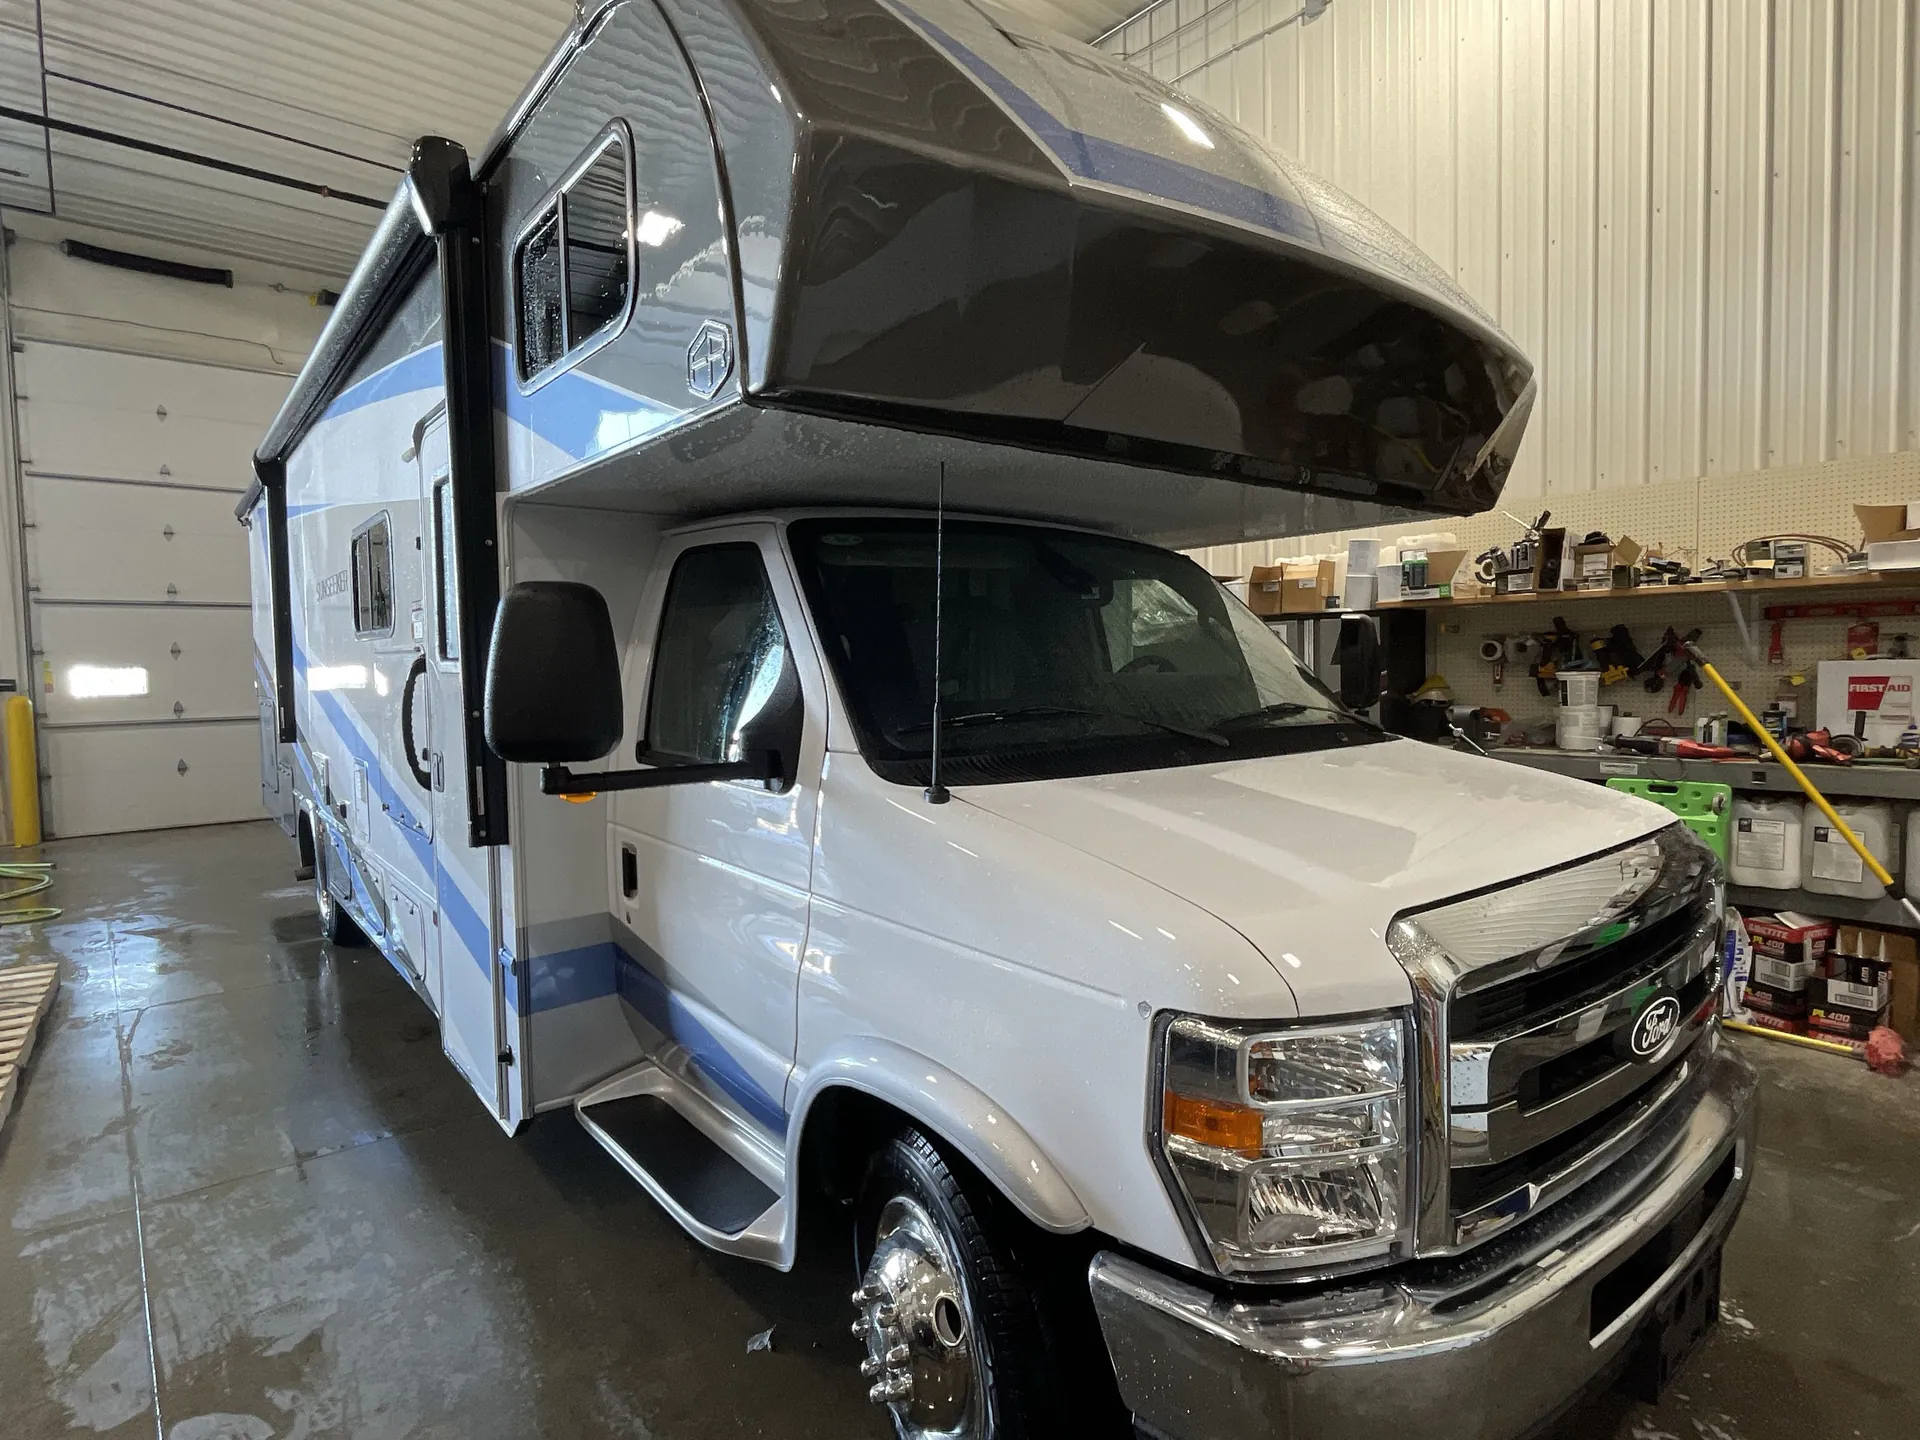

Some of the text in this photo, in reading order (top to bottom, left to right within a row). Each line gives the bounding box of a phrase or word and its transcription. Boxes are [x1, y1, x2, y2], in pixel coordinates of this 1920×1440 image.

[316, 569, 348, 602] SUNSEEKER
[1848, 684, 1911, 692] FIRST AID
[1765, 939, 1785, 949] 400
[1828, 1012, 1850, 1023] 400
[1641, 1005, 1673, 1049] Ford
